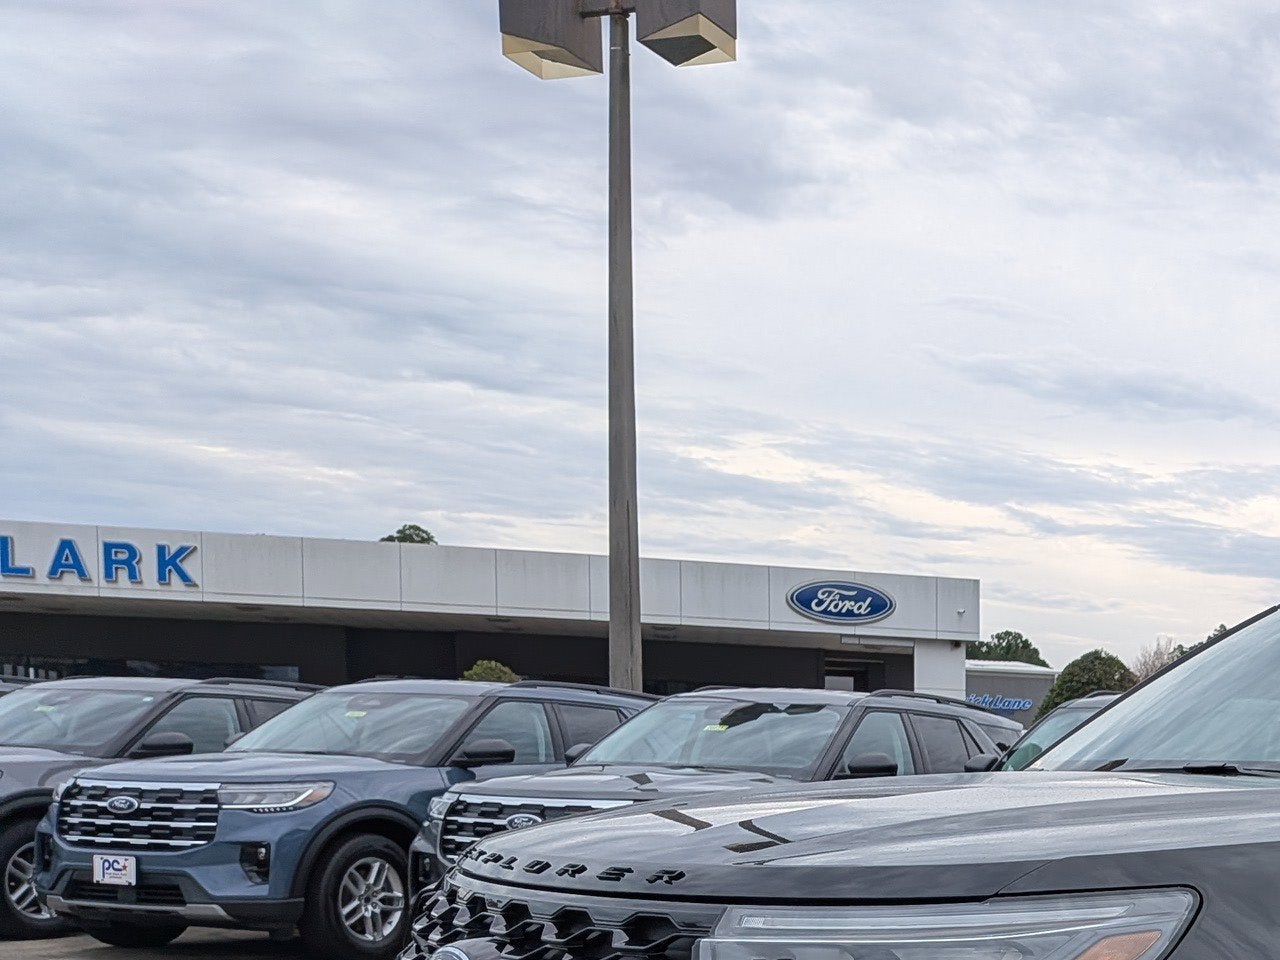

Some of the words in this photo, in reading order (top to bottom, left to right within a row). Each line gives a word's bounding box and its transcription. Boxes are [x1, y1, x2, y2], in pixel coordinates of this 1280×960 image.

[0, 535, 199, 587] LARK
[811, 588, 872, 615] Ford
[991, 694, 1033, 710] Lane
